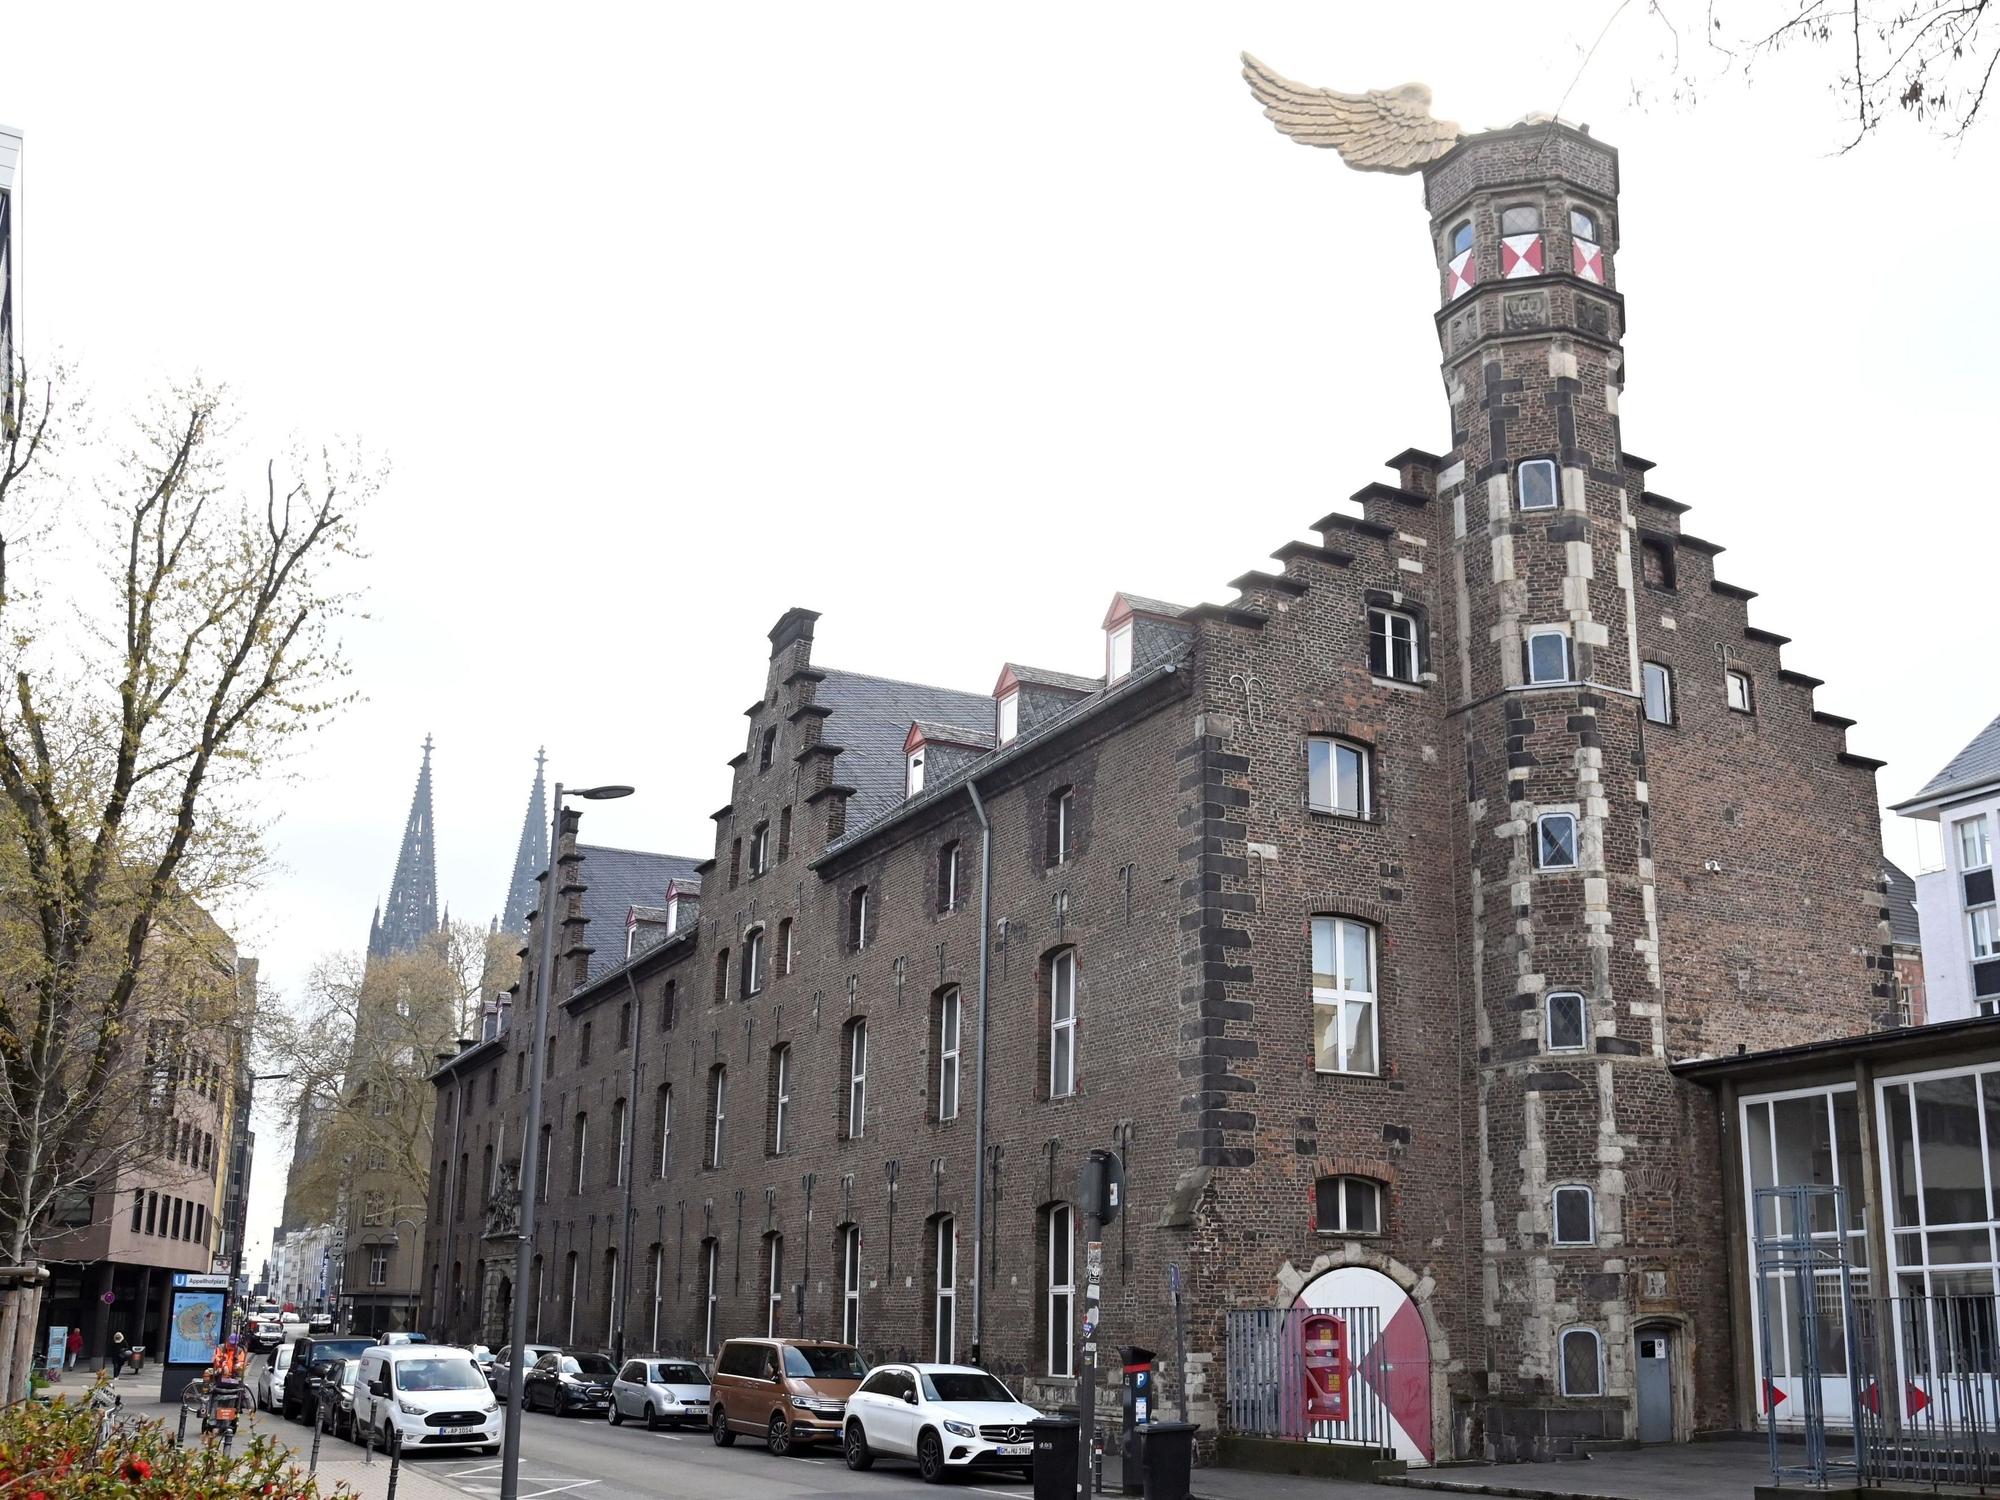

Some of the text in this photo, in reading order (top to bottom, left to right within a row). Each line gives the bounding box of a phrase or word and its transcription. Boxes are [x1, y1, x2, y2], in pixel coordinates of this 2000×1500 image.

[175, 1275, 227, 1286] U Appellhofplatz
[1137, 1373, 1145, 1386] P
